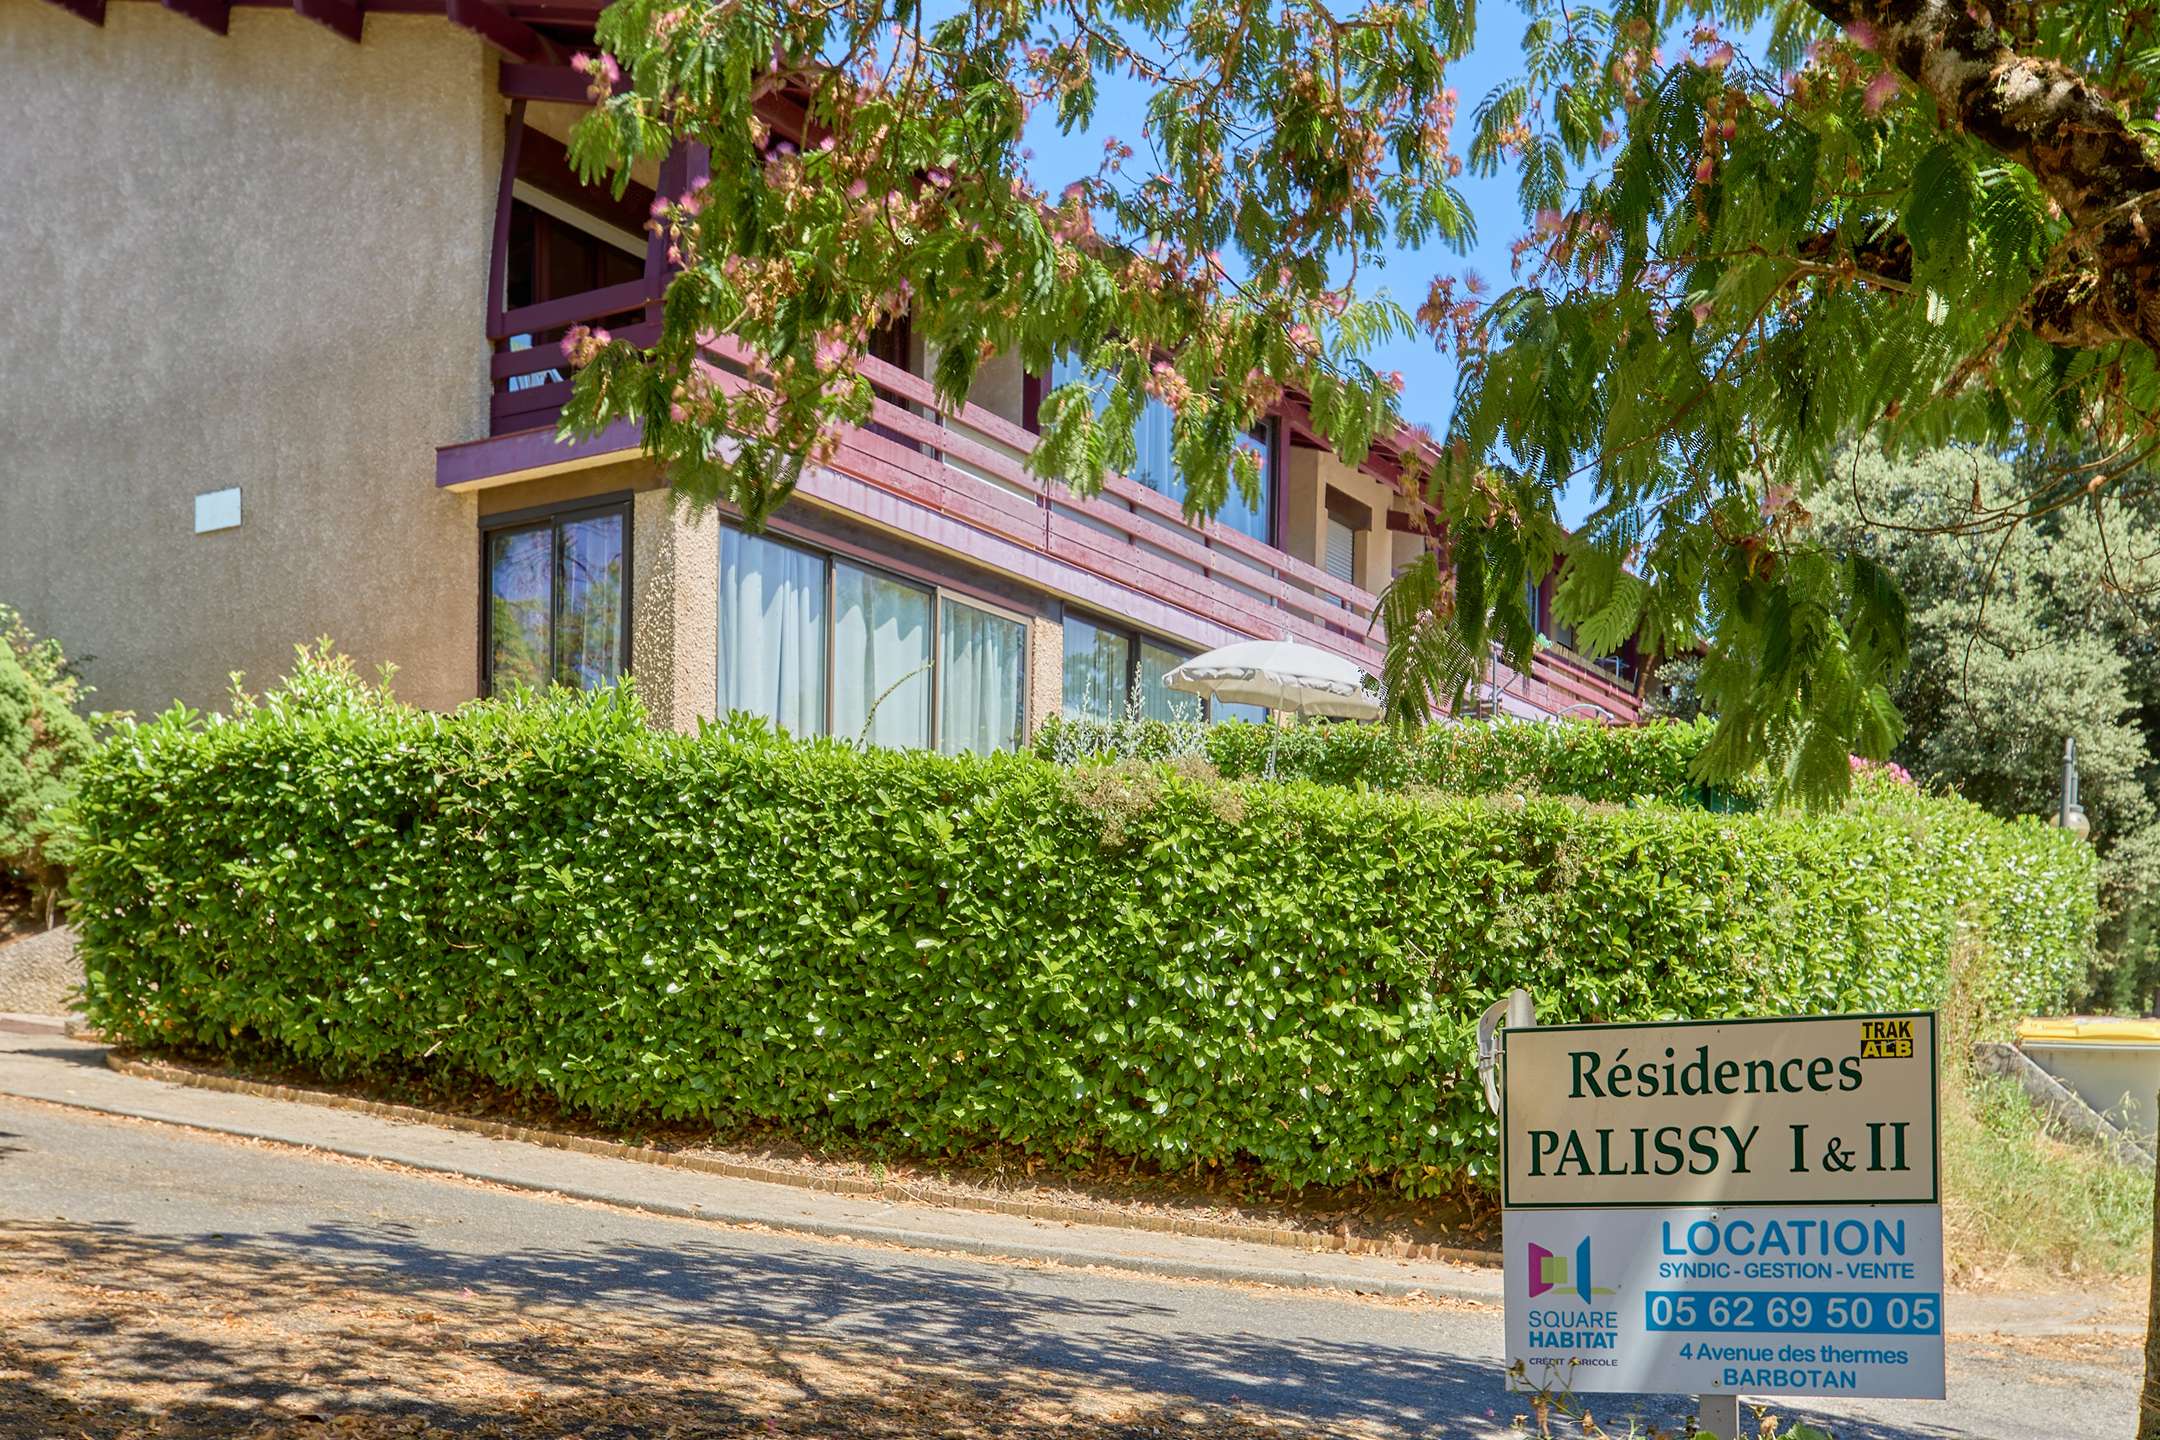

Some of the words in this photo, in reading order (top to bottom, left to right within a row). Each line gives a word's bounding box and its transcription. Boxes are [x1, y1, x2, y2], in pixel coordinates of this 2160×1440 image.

[1862, 1020, 1911, 1039] TRAK
[1862, 1040, 1912, 1057] ALB
[1568, 1045, 1863, 1098] Résidences
[1528, 1125, 1759, 1177] PALISSY
[1789, 1124, 1809, 1173] I
[1822, 1136, 1856, 1172] &
[1866, 1122, 1911, 1172] II
[1662, 1219, 1905, 1256] LOCATION
[1659, 1262, 1730, 1279] SYNDIC
[1743, 1263, 1832, 1279] GESTION
[1846, 1263, 1915, 1280] VENTE
[1528, 1310, 1618, 1328] SQUARE
[1651, 1296, 1697, 1327] 05
[1708, 1297, 1755, 1327] 62
[1766, 1297, 1813, 1328] 69
[1825, 1297, 1873, 1329] 50
[1886, 1298, 1935, 1329] 05
[1529, 1331, 1618, 1348] HABITAT
[1679, 1342, 1693, 1360] 4
[1696, 1343, 1774, 1362] Avenue
[1777, 1345, 1816, 1363] des
[1819, 1347, 1909, 1365] thermes
[1723, 1368, 1857, 1389] BARBOTAN
